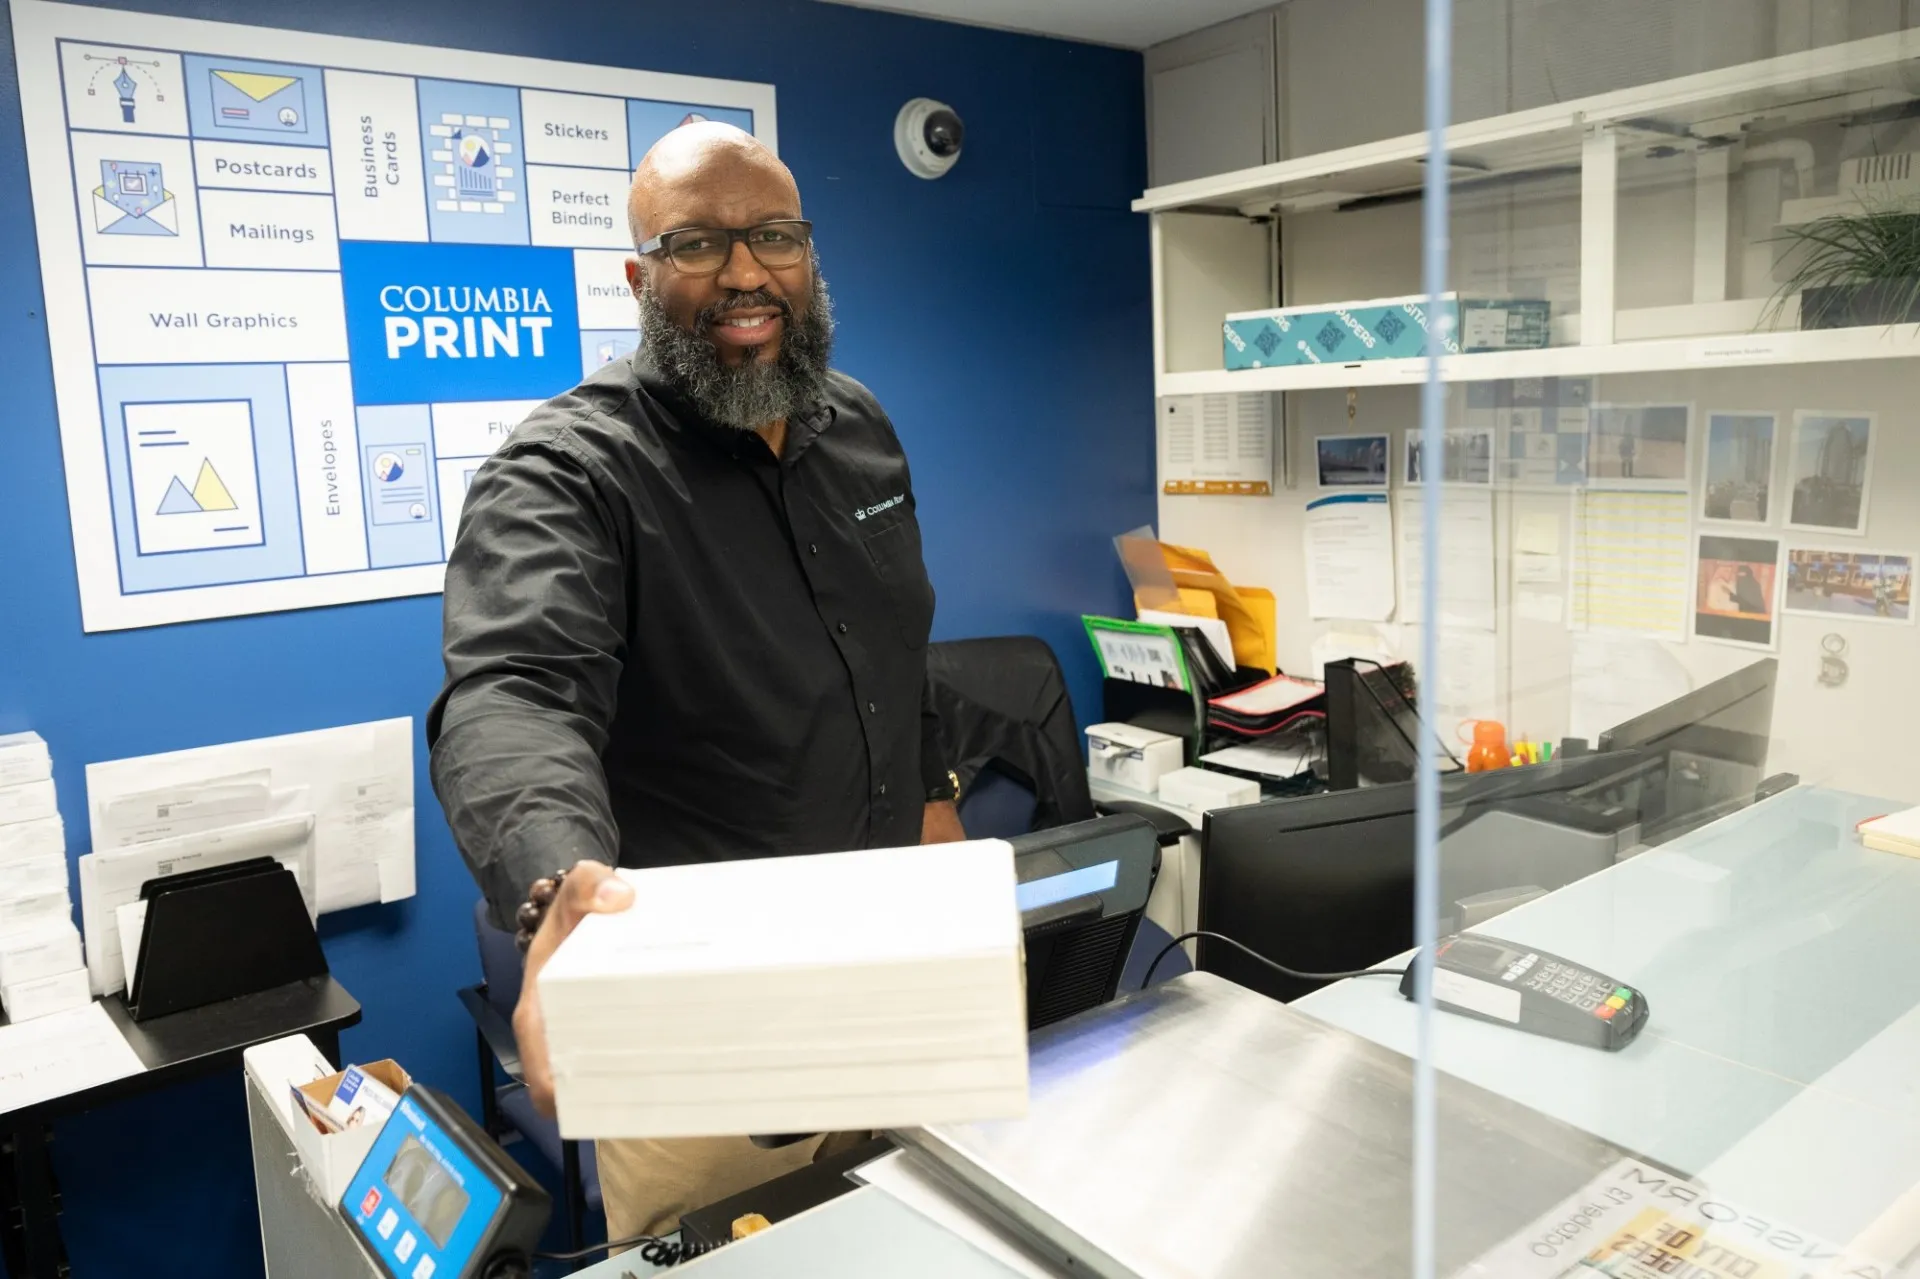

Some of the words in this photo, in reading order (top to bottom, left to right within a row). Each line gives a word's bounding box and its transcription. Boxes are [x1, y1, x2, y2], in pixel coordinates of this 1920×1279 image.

[545, 122, 609, 141] Stickers
[361, 114, 379, 198] Business
[382, 131, 399, 186] Cards
[215, 157, 318, 180] Postcards
[552, 190, 610, 207] Perfect
[552, 211, 613, 229] Binding
[229, 222, 315, 243] Mailings
[380, 285, 553, 313] COLUMBIA
[150, 312, 199, 329] Wall
[207, 312, 299, 332] Graphics
[384, 316, 553, 360] PRINT
[321, 418, 340, 517] Envelopes
